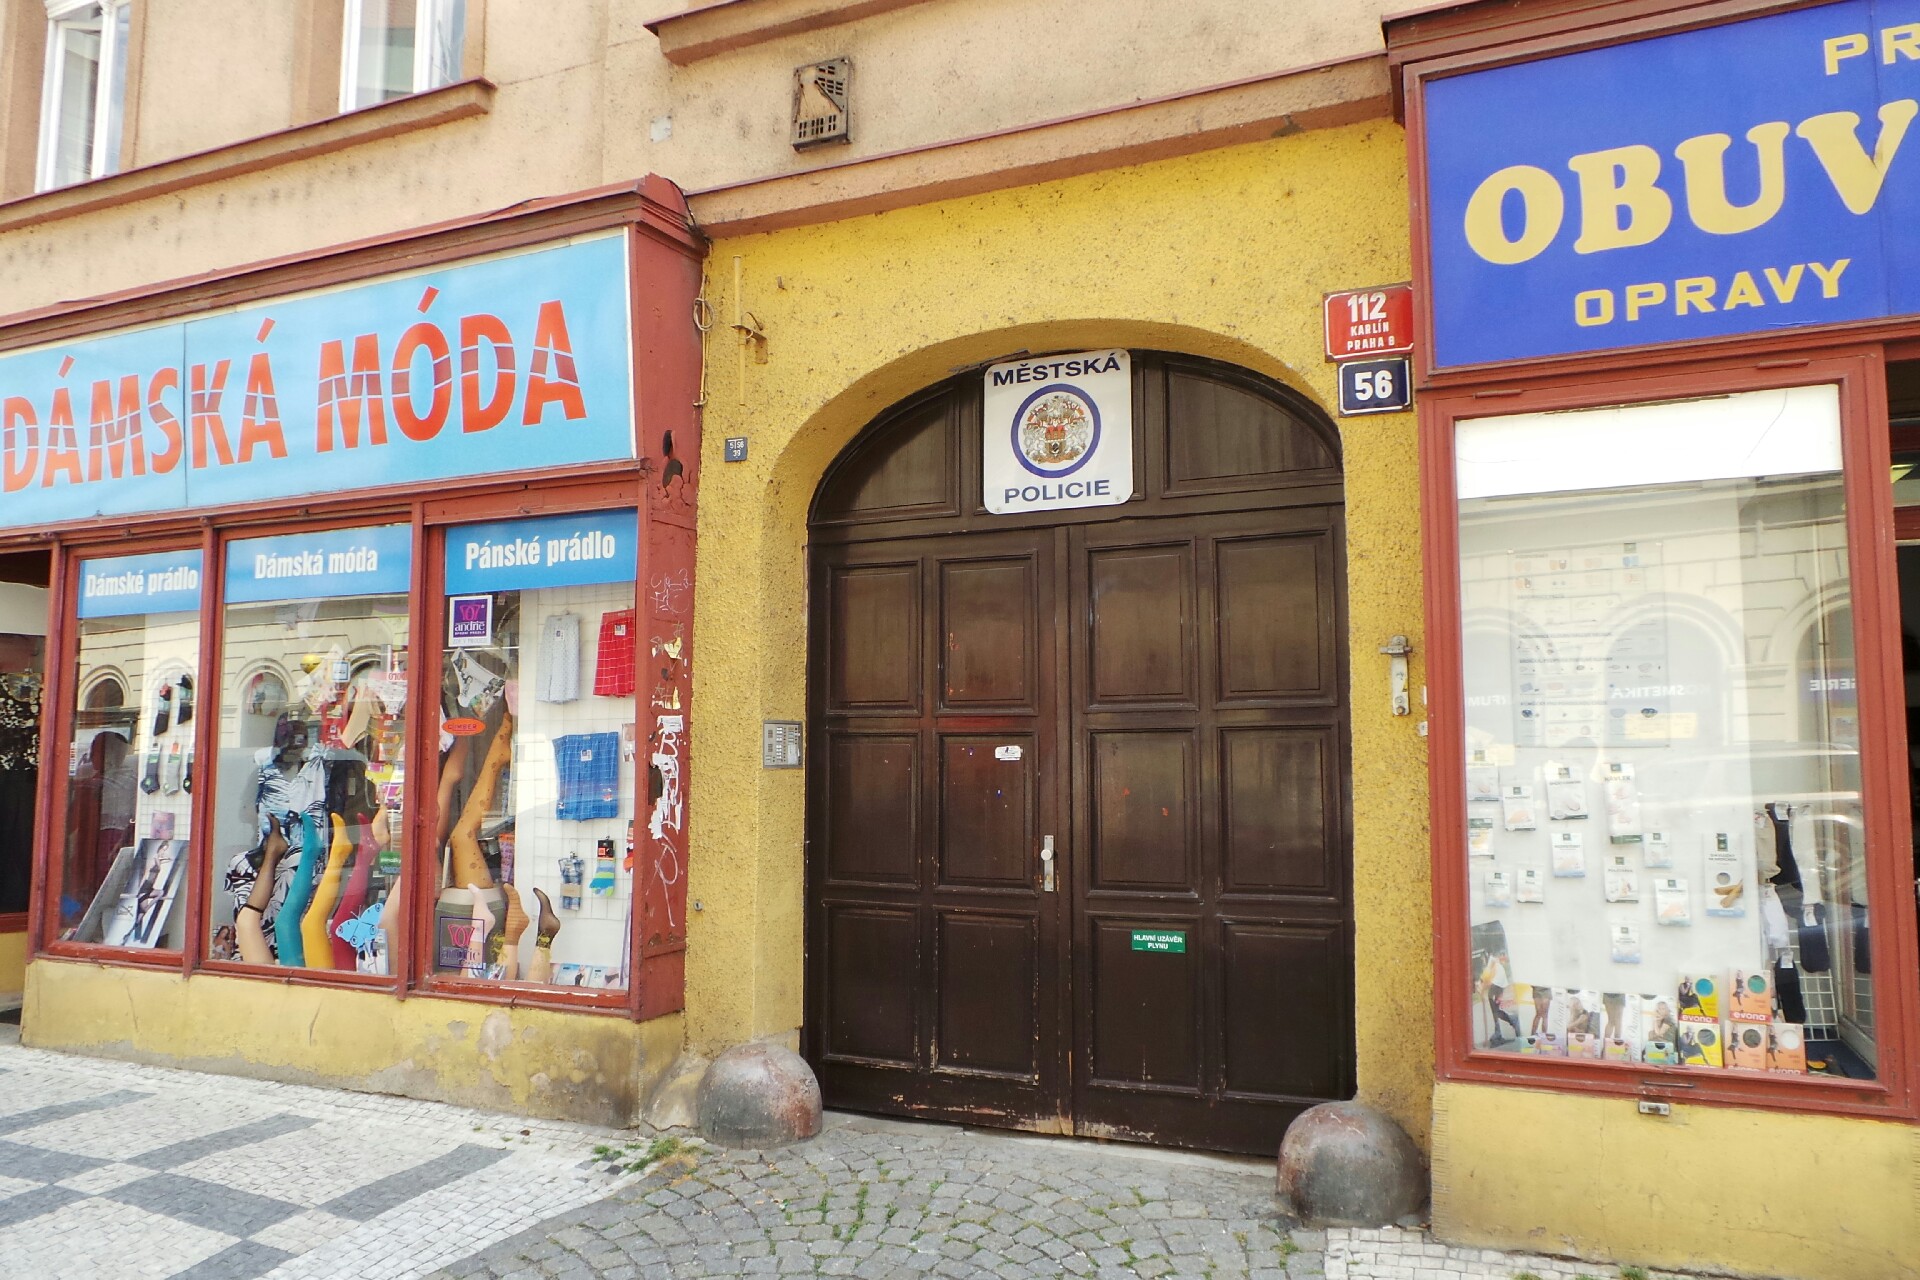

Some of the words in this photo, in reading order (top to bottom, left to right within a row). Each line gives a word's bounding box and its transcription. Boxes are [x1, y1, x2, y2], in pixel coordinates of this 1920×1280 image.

[1464, 98, 1919, 265] OBUV
[1347, 291, 1387, 323] 112
[1574, 258, 1851, 328] OPRAVY
[1347, 336, 1385, 351] PRAHA
[1388, 335, 1396, 346] 8
[1350, 318, 1390, 337] KARLÍN
[993, 352, 1121, 387] MĚSTSKÁ
[1354, 369, 1394, 401] 56
[3, 317, 287, 493] DÁMSKÁ
[316, 286, 587, 454] MÓDA
[1004, 479, 1111, 504] POLICIE
[255, 549, 324, 579] Dámská
[328, 546, 378, 574] móda
[466, 535, 541, 570] Pánské
[547, 530, 616, 567] prádlo
[85, 570, 144, 597] Dámské
[147, 566, 199, 595] prádlo
[454, 620, 486, 632] andrie
[1133, 934, 1156, 942] HLAVNÍ
[1157, 934, 1183, 943] UZÁVĚR
[1147, 942, 1169, 950] PLYNU
[1682, 1013, 1713, 1023] evona
[1733, 1011, 1766, 1021] evona
